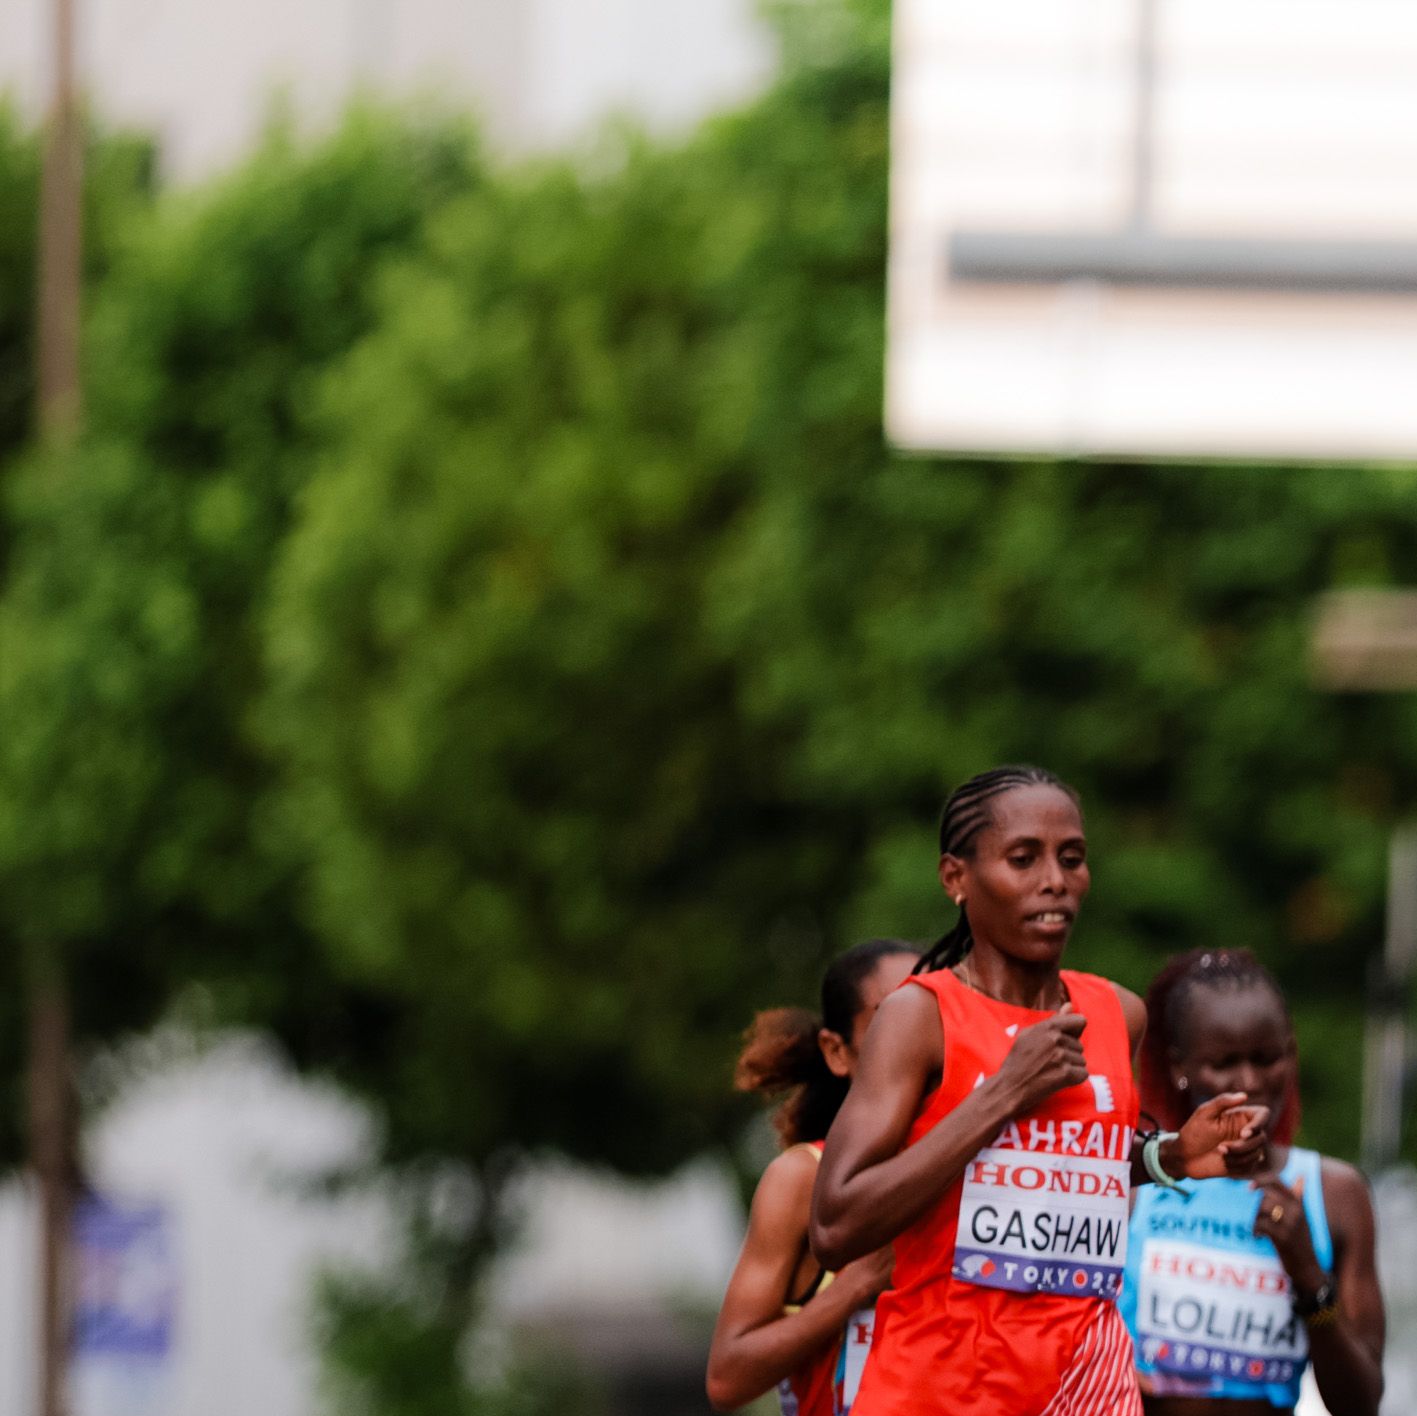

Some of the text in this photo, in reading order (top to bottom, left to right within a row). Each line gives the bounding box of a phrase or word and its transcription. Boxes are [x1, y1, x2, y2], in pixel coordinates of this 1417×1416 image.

[968, 1161, 1126, 1199] HONDA
[971, 1204, 1122, 1258] GASHAW
[1151, 1252, 1289, 1296] HOND
[1151, 1291, 1297, 1348] LOLIHA
